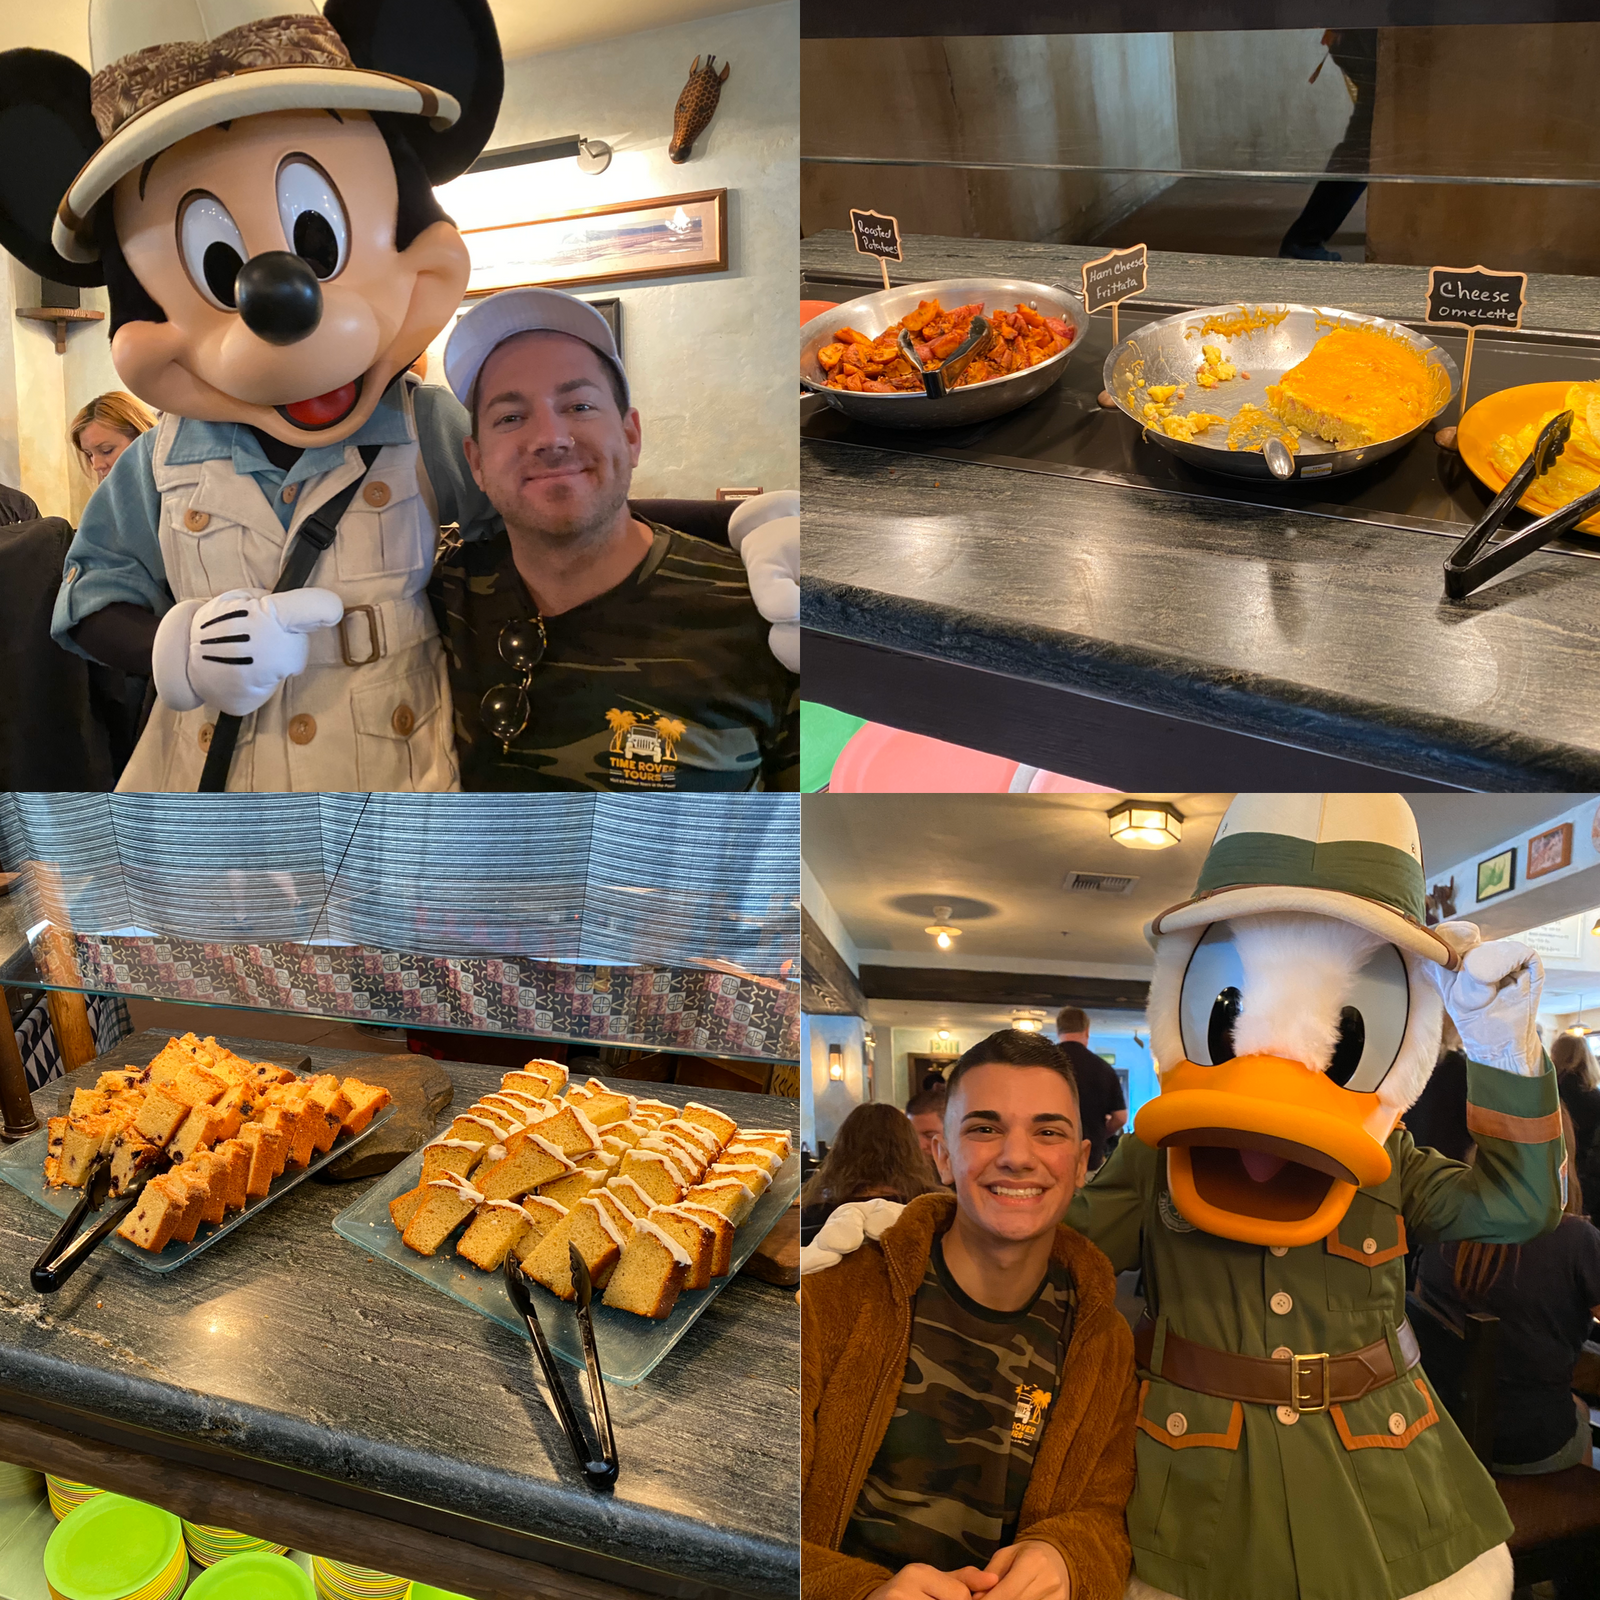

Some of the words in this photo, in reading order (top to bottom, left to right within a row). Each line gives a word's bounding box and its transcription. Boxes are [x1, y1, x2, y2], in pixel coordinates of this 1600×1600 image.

[857, 219, 892, 239] Roasted
[1089, 267, 1113, 283] Ham
[1113, 256, 1144, 275] Cheese
[1440, 280, 1510, 303] Cheese
[609, 756, 637, 770] TIME
[637, 761, 677, 773] ROVER
[623, 769, 663, 782] TOURS
